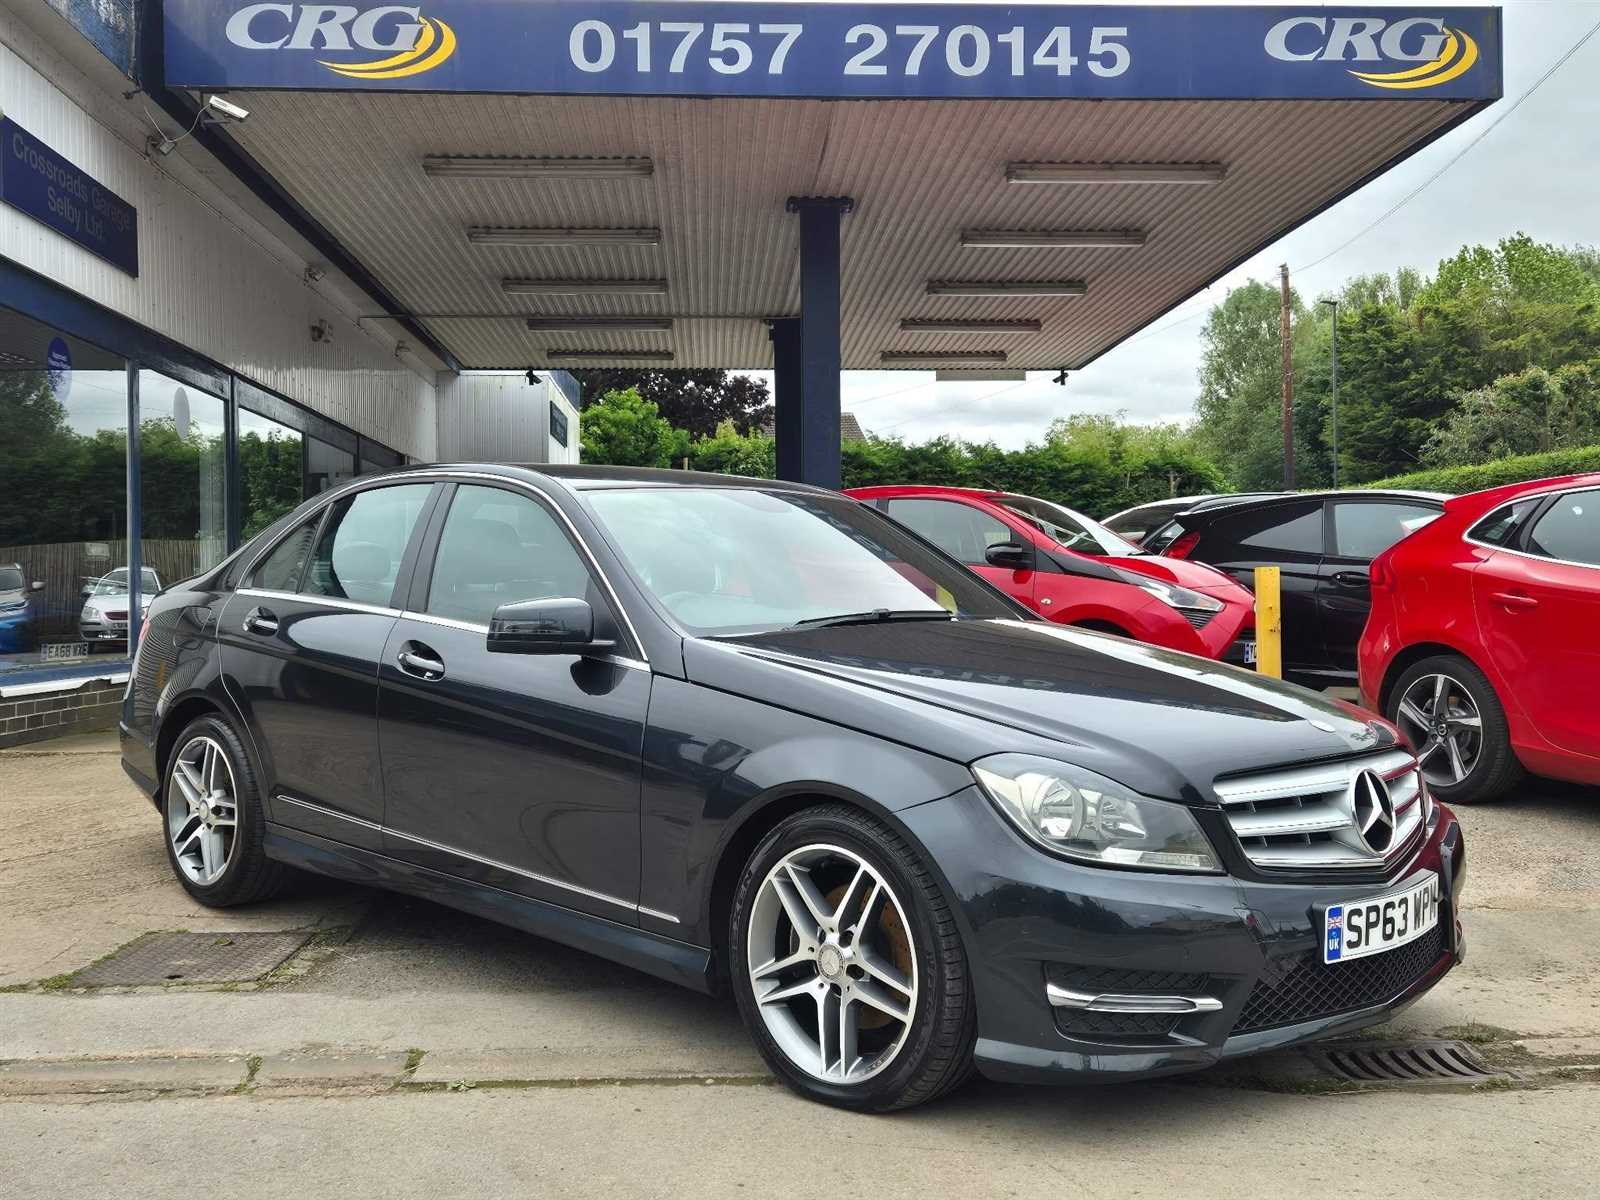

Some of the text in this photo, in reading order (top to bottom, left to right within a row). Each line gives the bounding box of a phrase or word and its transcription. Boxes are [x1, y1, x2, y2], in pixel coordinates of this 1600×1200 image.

[226, 4, 427, 51] CRG
[568, 20, 1131, 77] 01757 270145
[1264, 17, 1451, 62] CRG
[12, 132, 88, 203] Crossroads
[47, 187, 81, 232] Selby
[1328, 938, 1340, 951] UK
[1346, 896, 1409, 949] SP63
